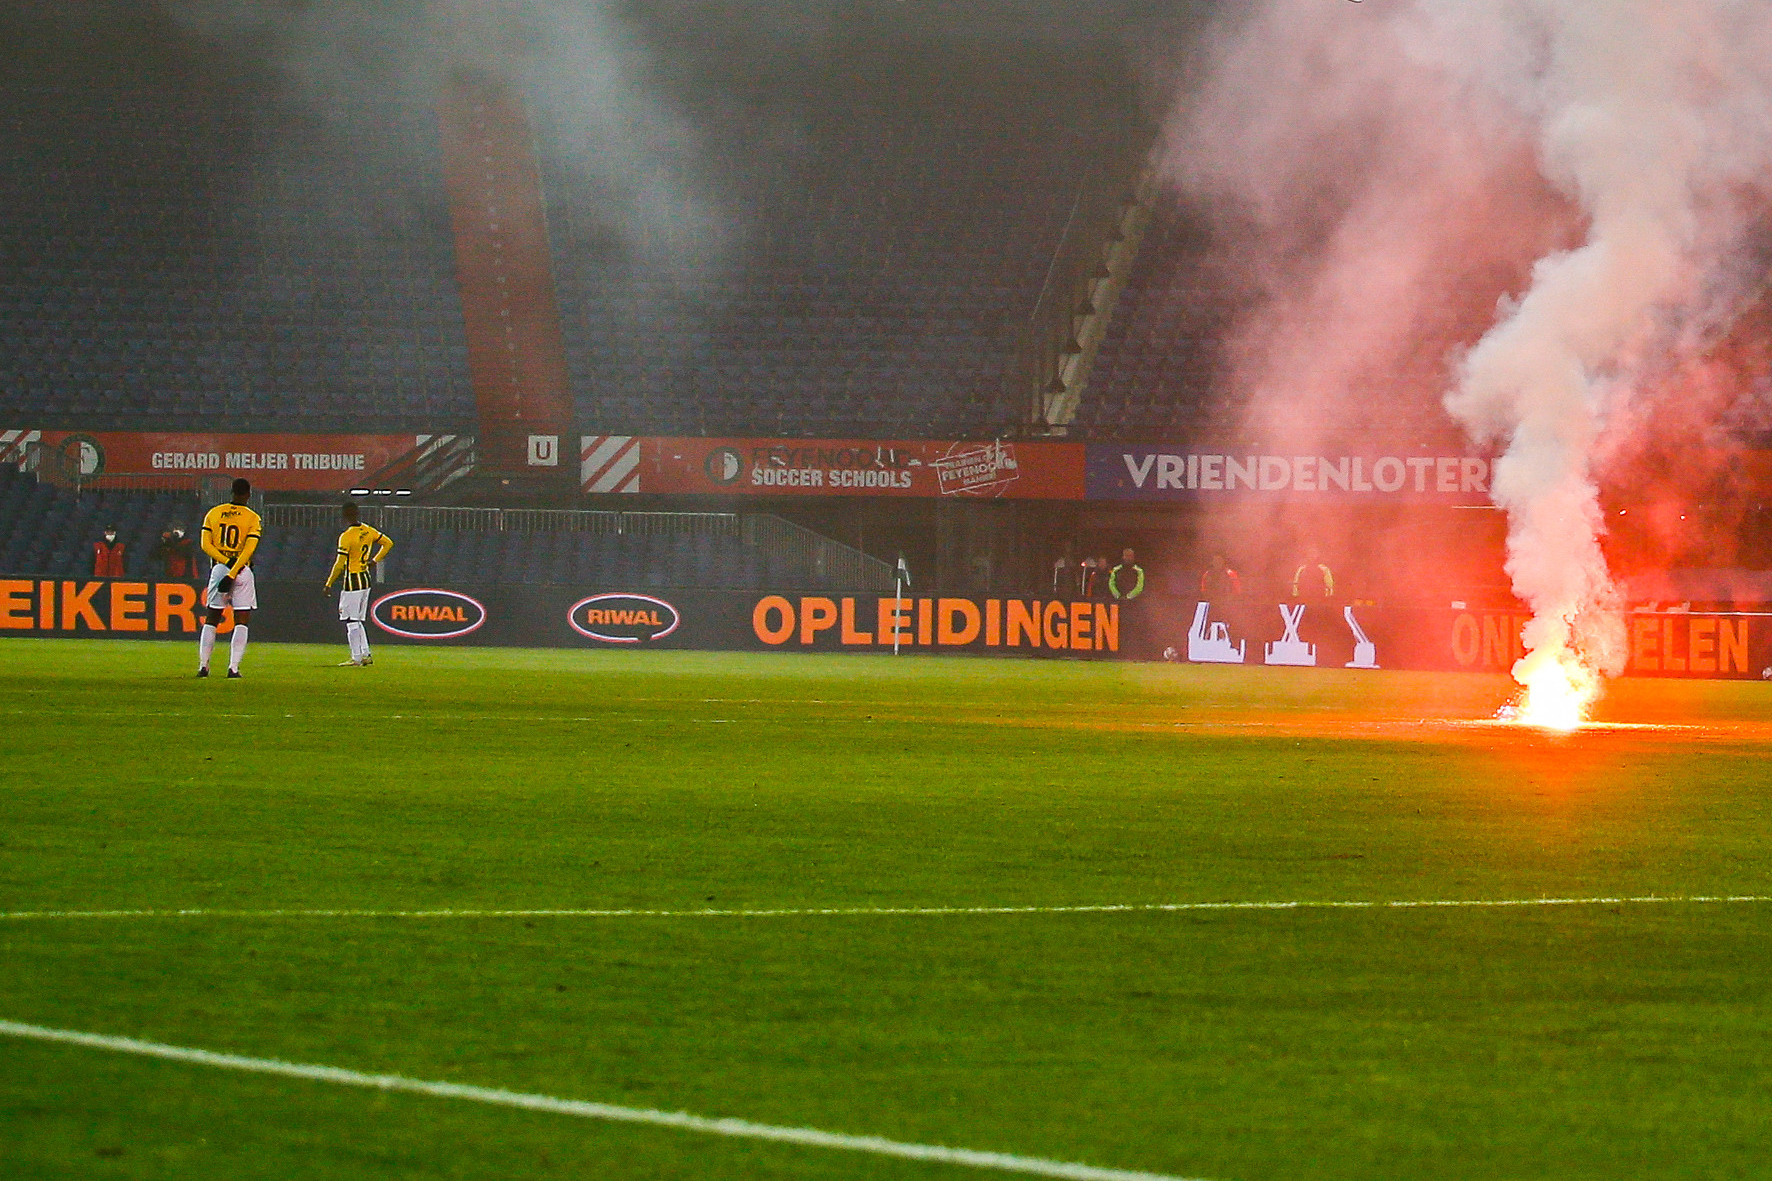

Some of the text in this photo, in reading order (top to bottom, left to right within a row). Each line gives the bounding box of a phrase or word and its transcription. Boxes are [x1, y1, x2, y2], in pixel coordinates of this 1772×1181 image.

[151, 451, 365, 471] GERARD MEIJER TRIBUNE
[535, 442, 551, 461] U
[751, 468, 912, 488] SOCCER SCHOOLS
[219, 523, 239, 549] 10
[361, 544, 369, 564] 2
[391, 604, 468, 623] RIWAL
[587, 608, 662, 627] RIWAL
[753, 596, 1119, 651] OPLEIDINGEN
